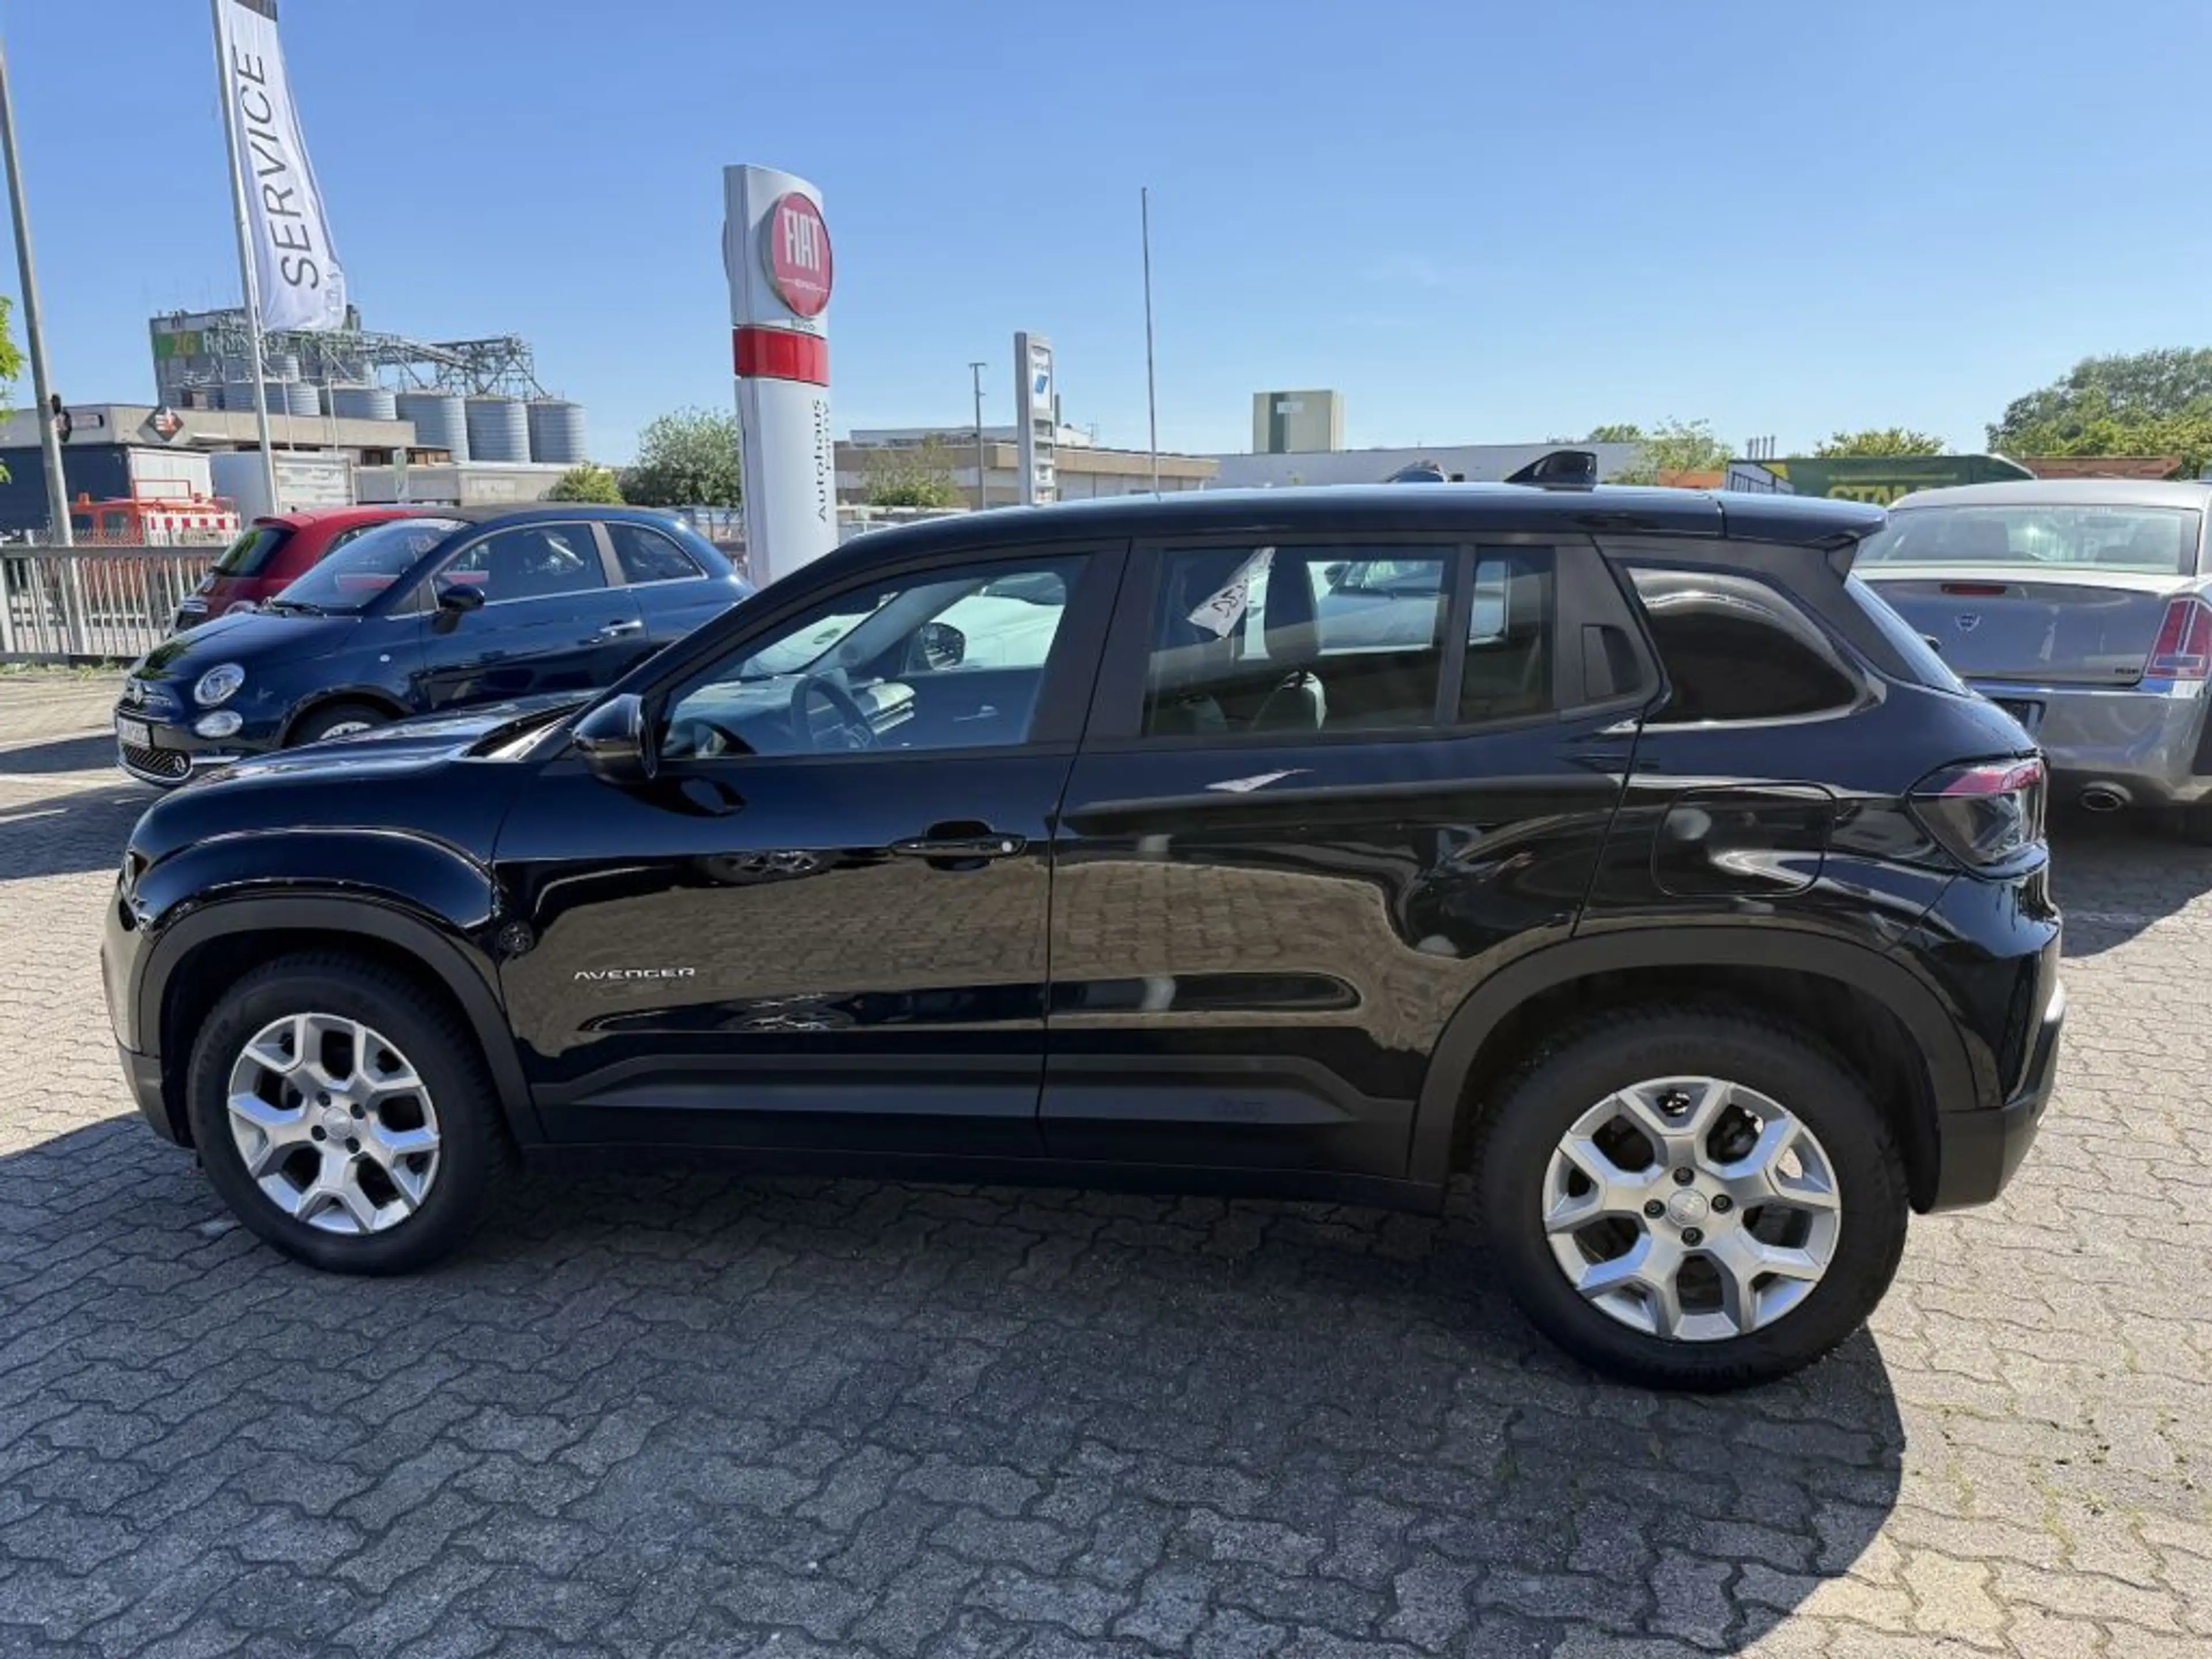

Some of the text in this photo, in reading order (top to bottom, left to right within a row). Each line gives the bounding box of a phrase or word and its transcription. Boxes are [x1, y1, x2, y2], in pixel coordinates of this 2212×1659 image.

[232, 44, 319, 290] SERVICE
[782, 207, 820, 272] FIAT
[812, 399, 827, 522] Autohaus
[574, 967, 695, 980] AVENGER
